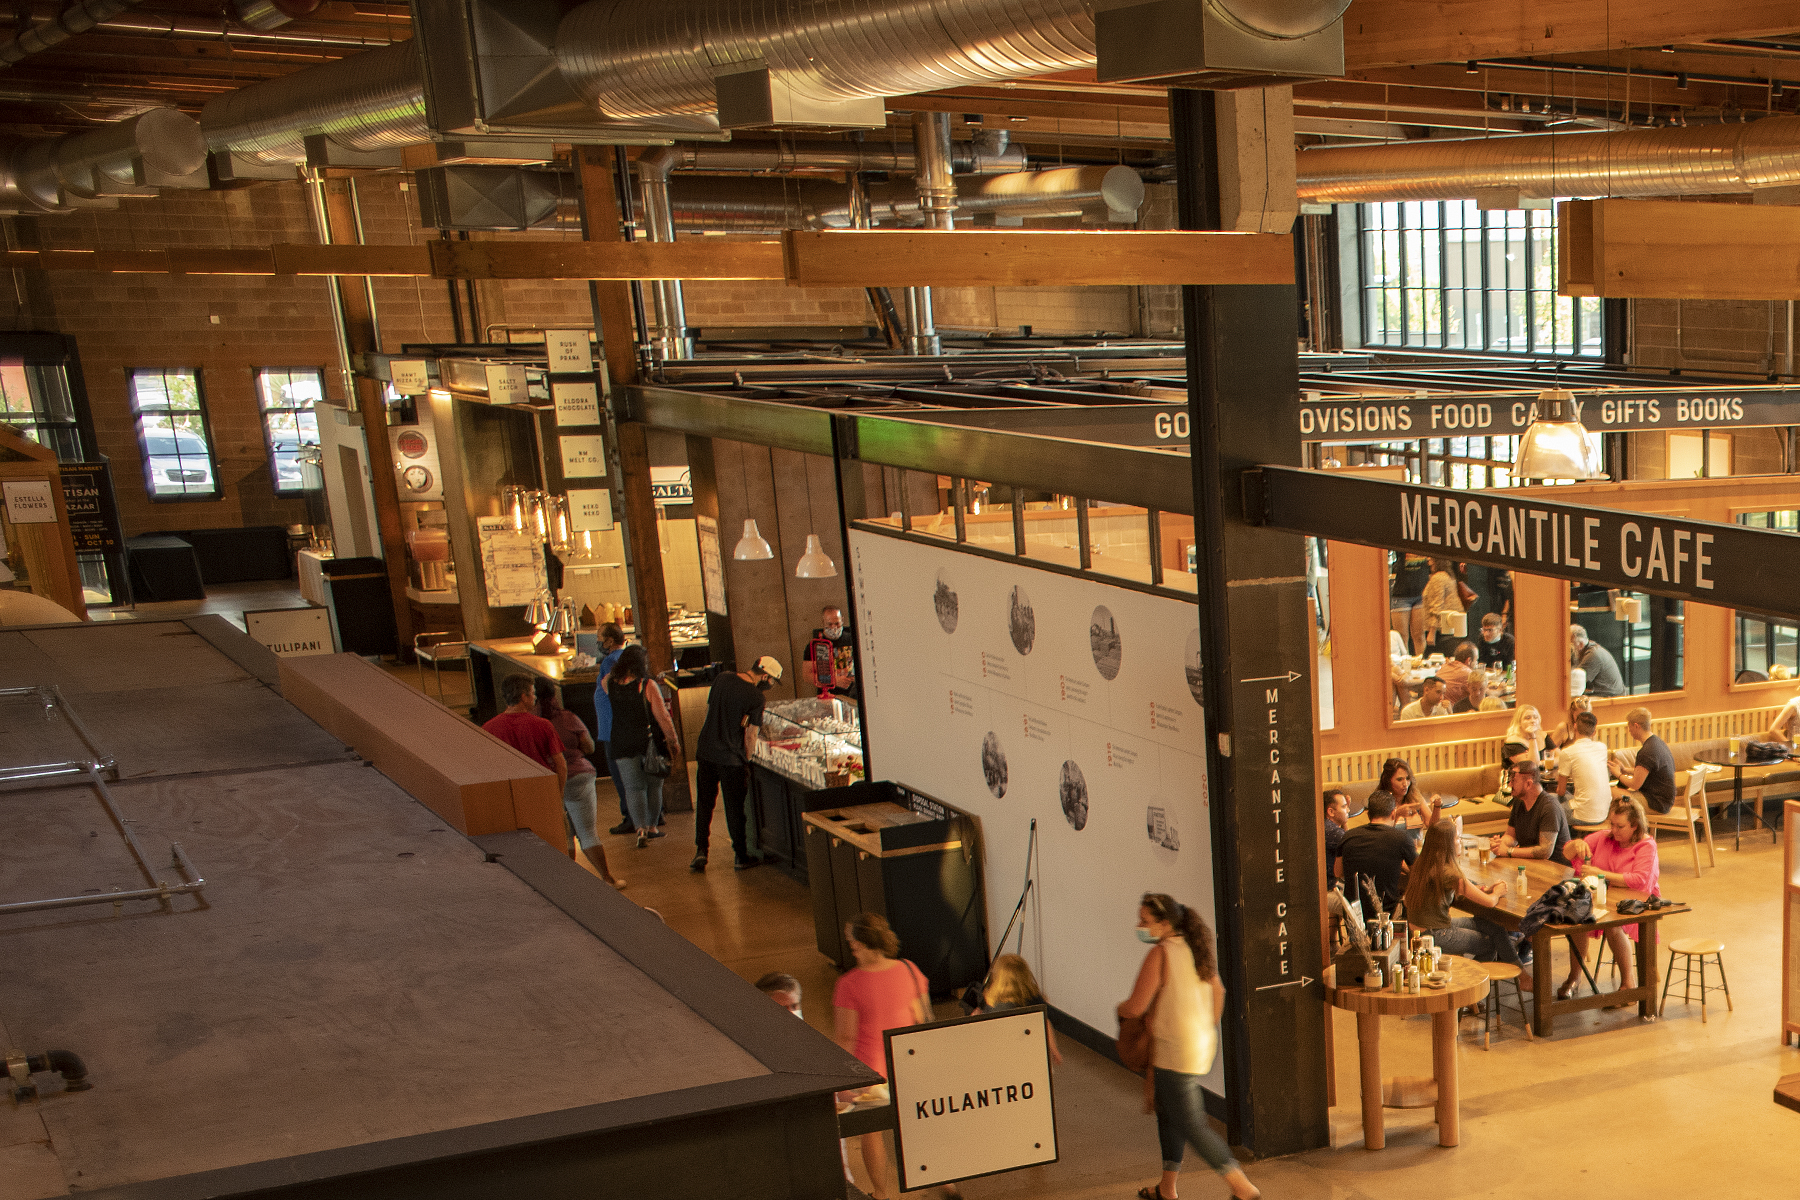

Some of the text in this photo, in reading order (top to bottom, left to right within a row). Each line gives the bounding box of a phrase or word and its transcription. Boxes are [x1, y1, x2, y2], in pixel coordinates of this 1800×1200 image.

[1299, 405, 1412, 434] OVISIONS
[1431, 403, 1492, 429] FOOD
[1511, 401, 1584, 427] CAY
[1601, 399, 1661, 424] GIFTS
[1677, 397, 1743, 422] BOOKS
[64, 488, 99, 497] TISAN
[66, 503, 95, 511] AZAAR
[1400, 491, 1714, 590] MERCANTILE CAFE
[266, 641, 321, 653] TULIPANI
[1266, 688, 1289, 976] MERCANTILE CAFE
[916, 1081, 1034, 1120] KULANTRO
